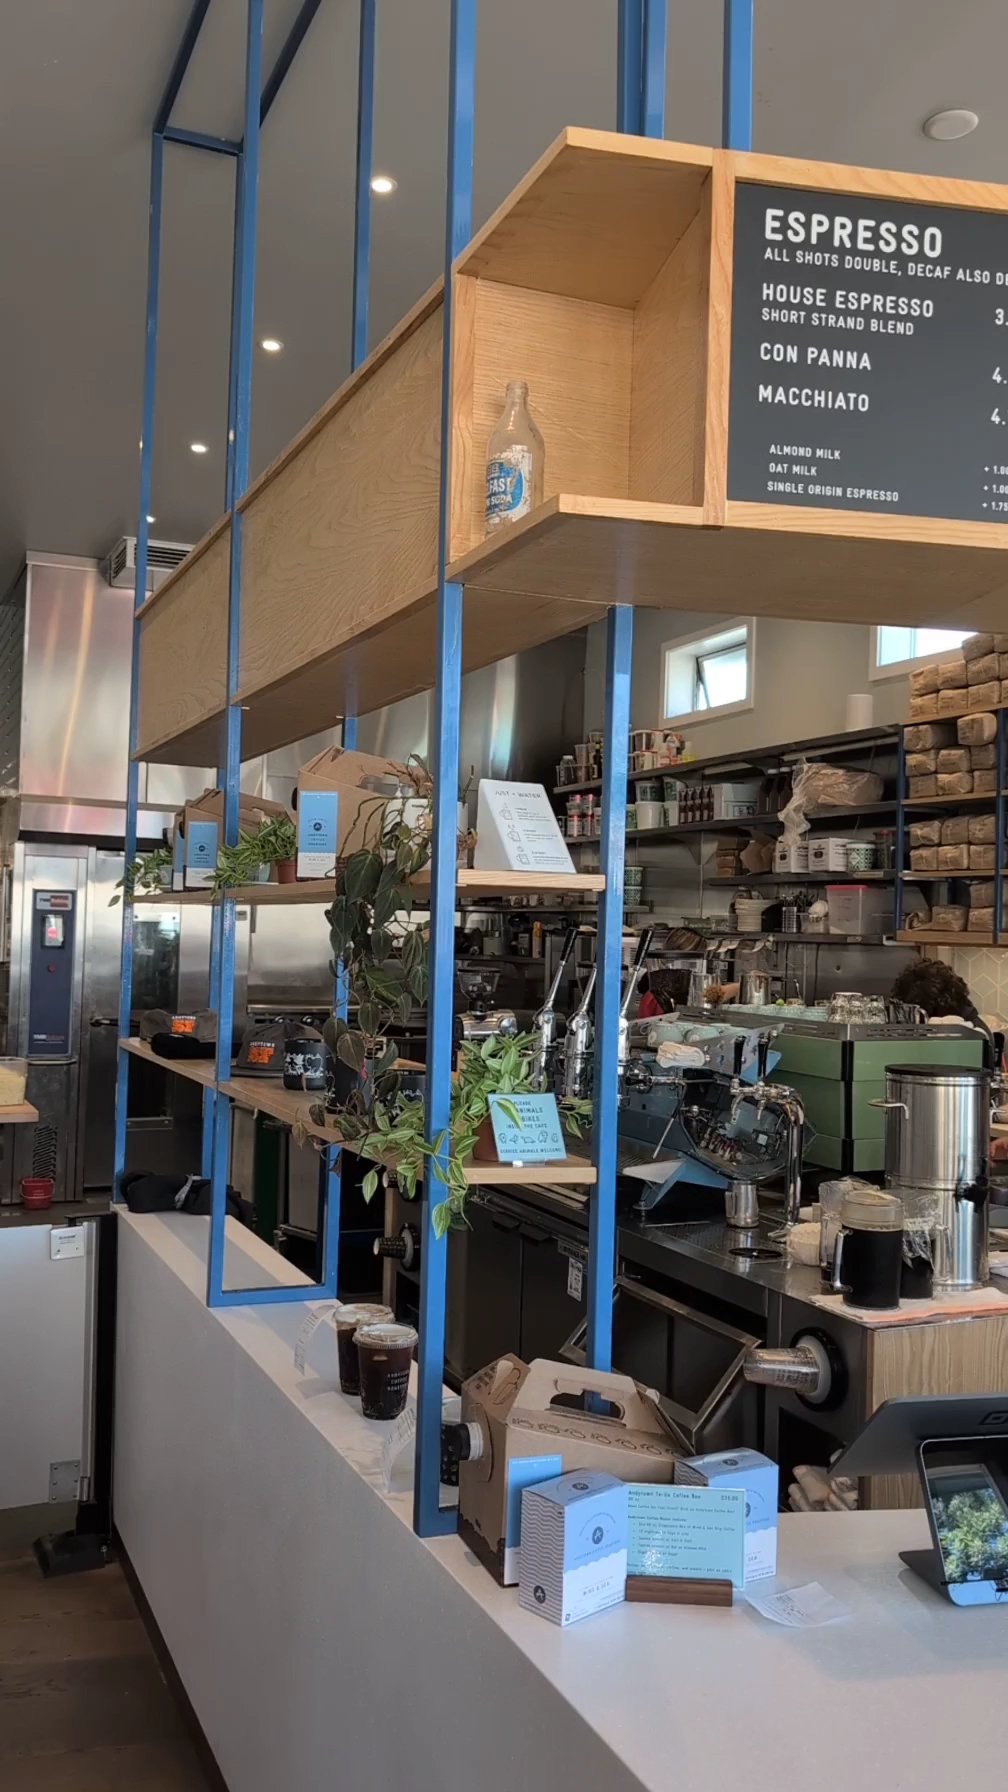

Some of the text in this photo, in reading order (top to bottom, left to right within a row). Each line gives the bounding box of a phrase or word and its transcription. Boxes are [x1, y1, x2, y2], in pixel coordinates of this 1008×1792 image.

[764, 207, 942, 258] ESPRESSO
[764, 246, 790, 263] ALL
[796, 250, 838, 268] SHOTS
[845, 255, 902, 277] DOUBLE,
[908, 262, 951, 280] DECAF
[956, 267, 990, 284] ALSO
[763, 282, 933, 318] HOUSE ESPRESSO
[761, 307, 914, 336] SHORT STRAND BLEND
[760, 342, 871, 371] CON PANNA
[759, 383, 869, 413] MACCHIATO
[769, 443, 841, 460] ALMOND MILK
[769, 462, 817, 477] OAT MILK
[767, 481, 899, 502] SINGLE ORIGIN ESPRESSO
